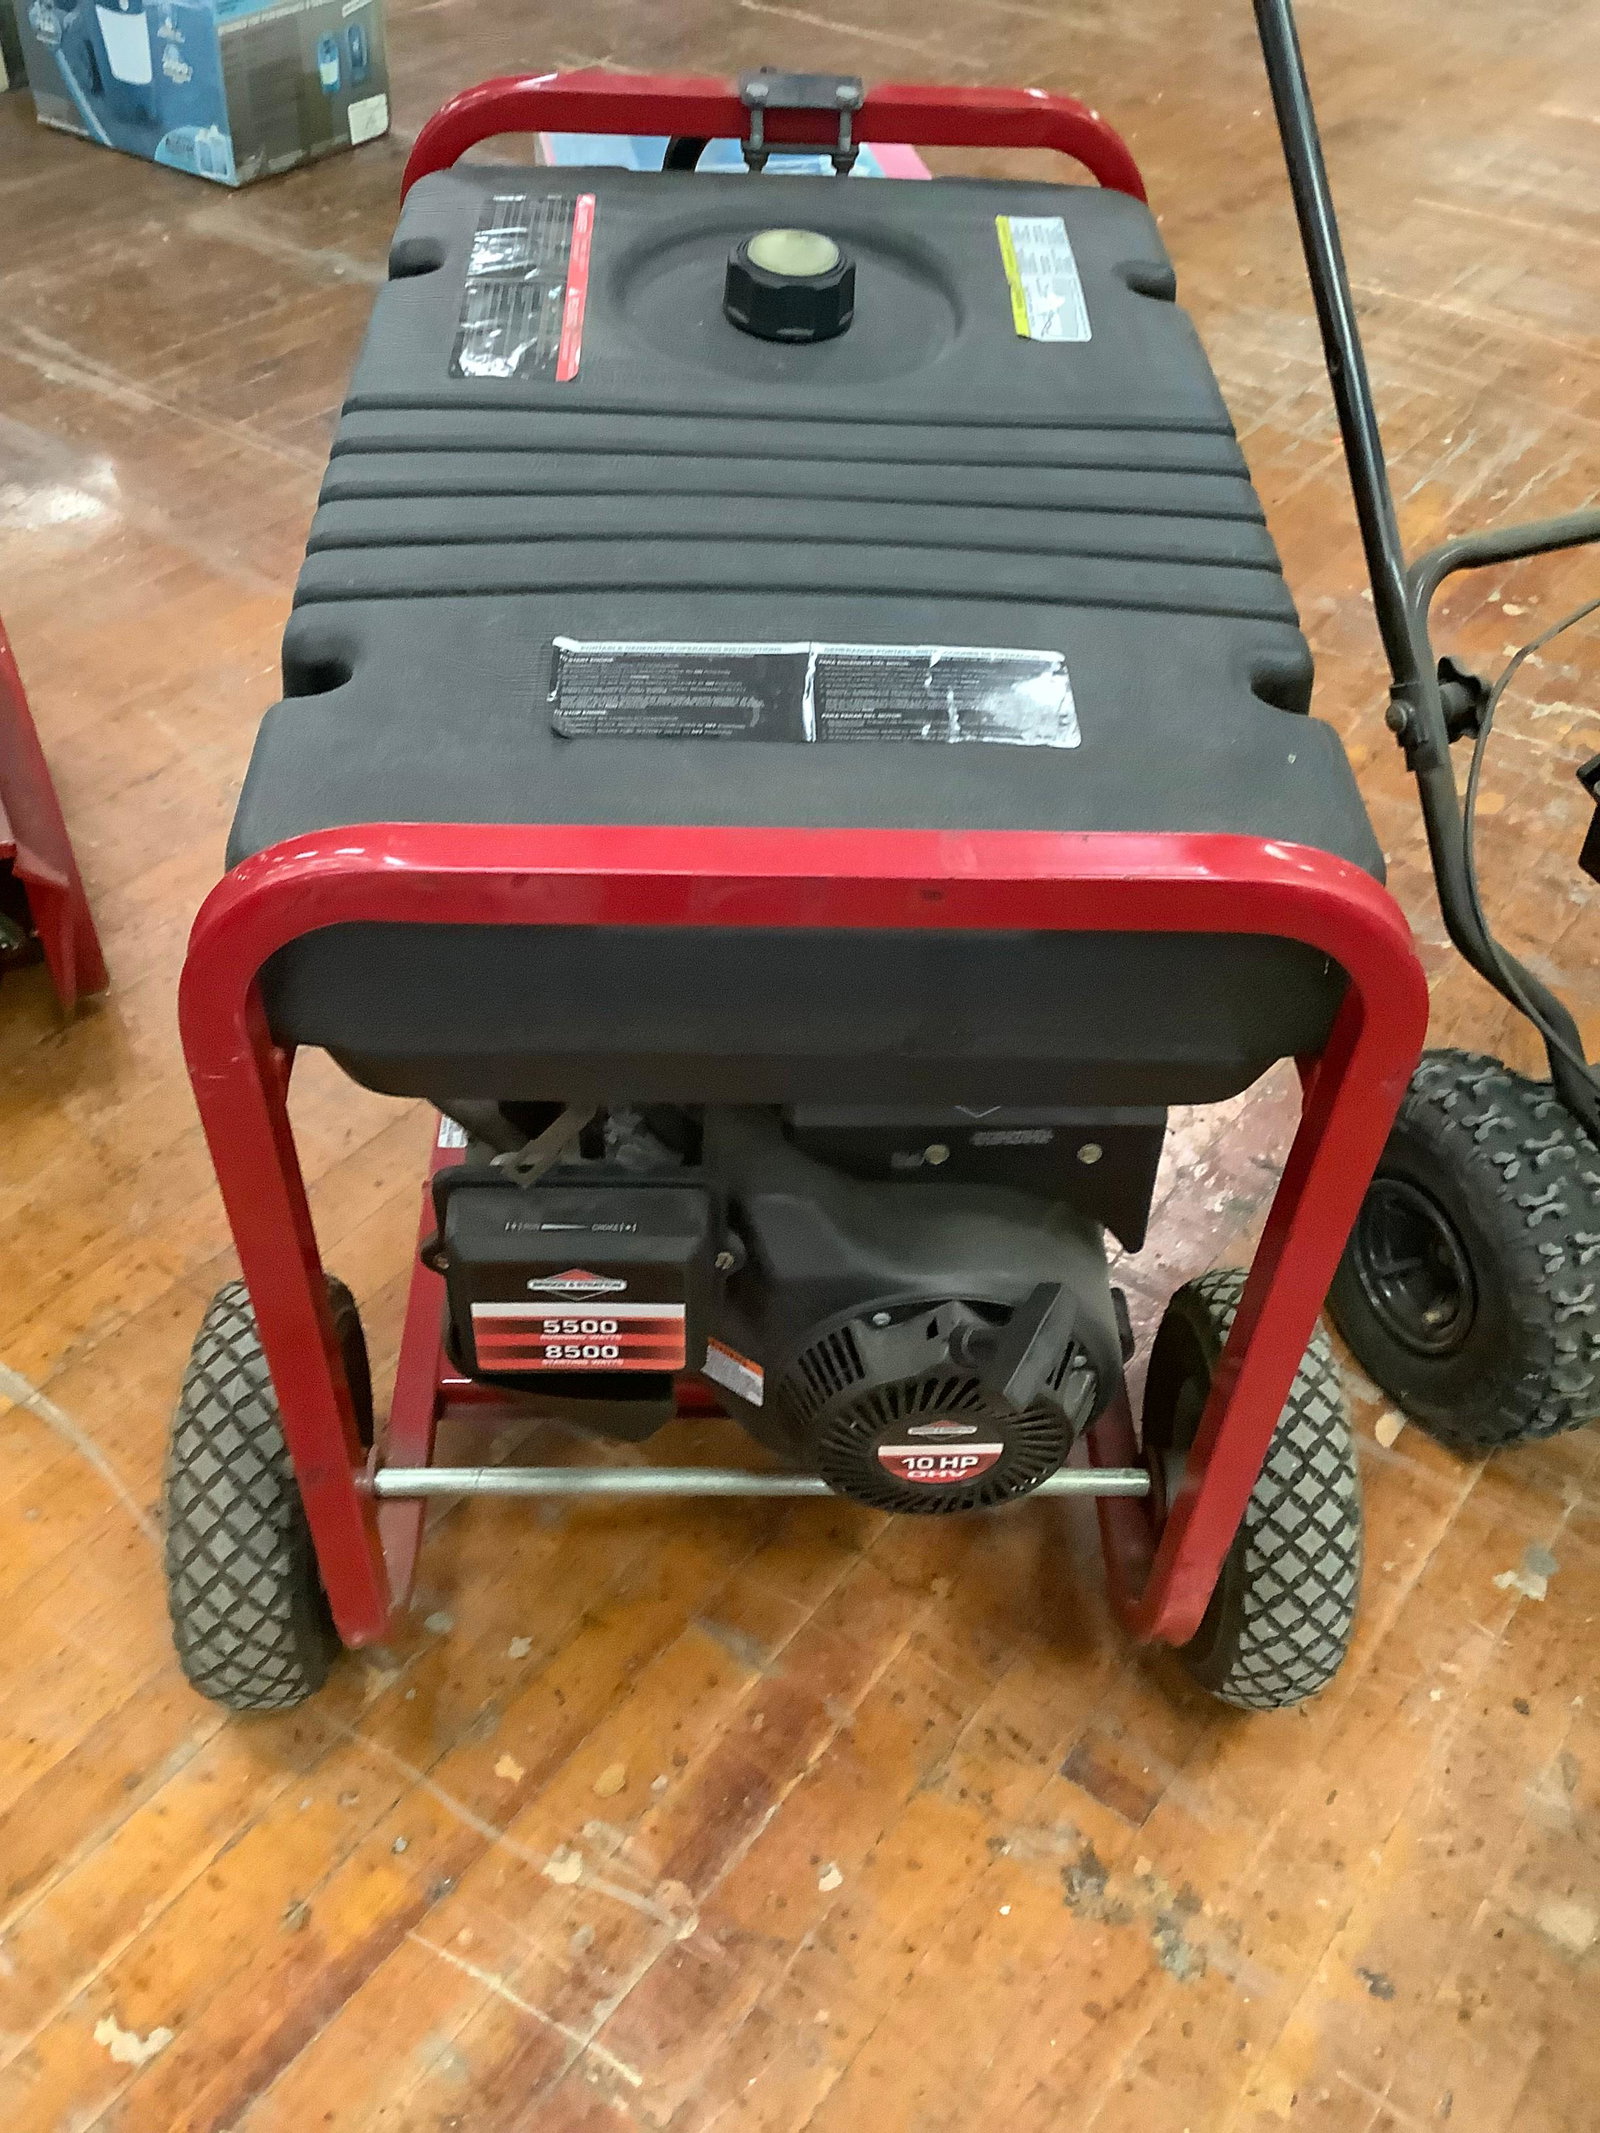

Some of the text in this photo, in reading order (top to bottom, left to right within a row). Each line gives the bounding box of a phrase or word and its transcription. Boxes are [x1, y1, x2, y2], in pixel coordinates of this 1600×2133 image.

[543, 1319, 618, 1334] 5500
[545, 1345, 619, 1359] 8500
[901, 1455, 979, 1470] 10 HP
[907, 1470, 968, 1478] OHV
